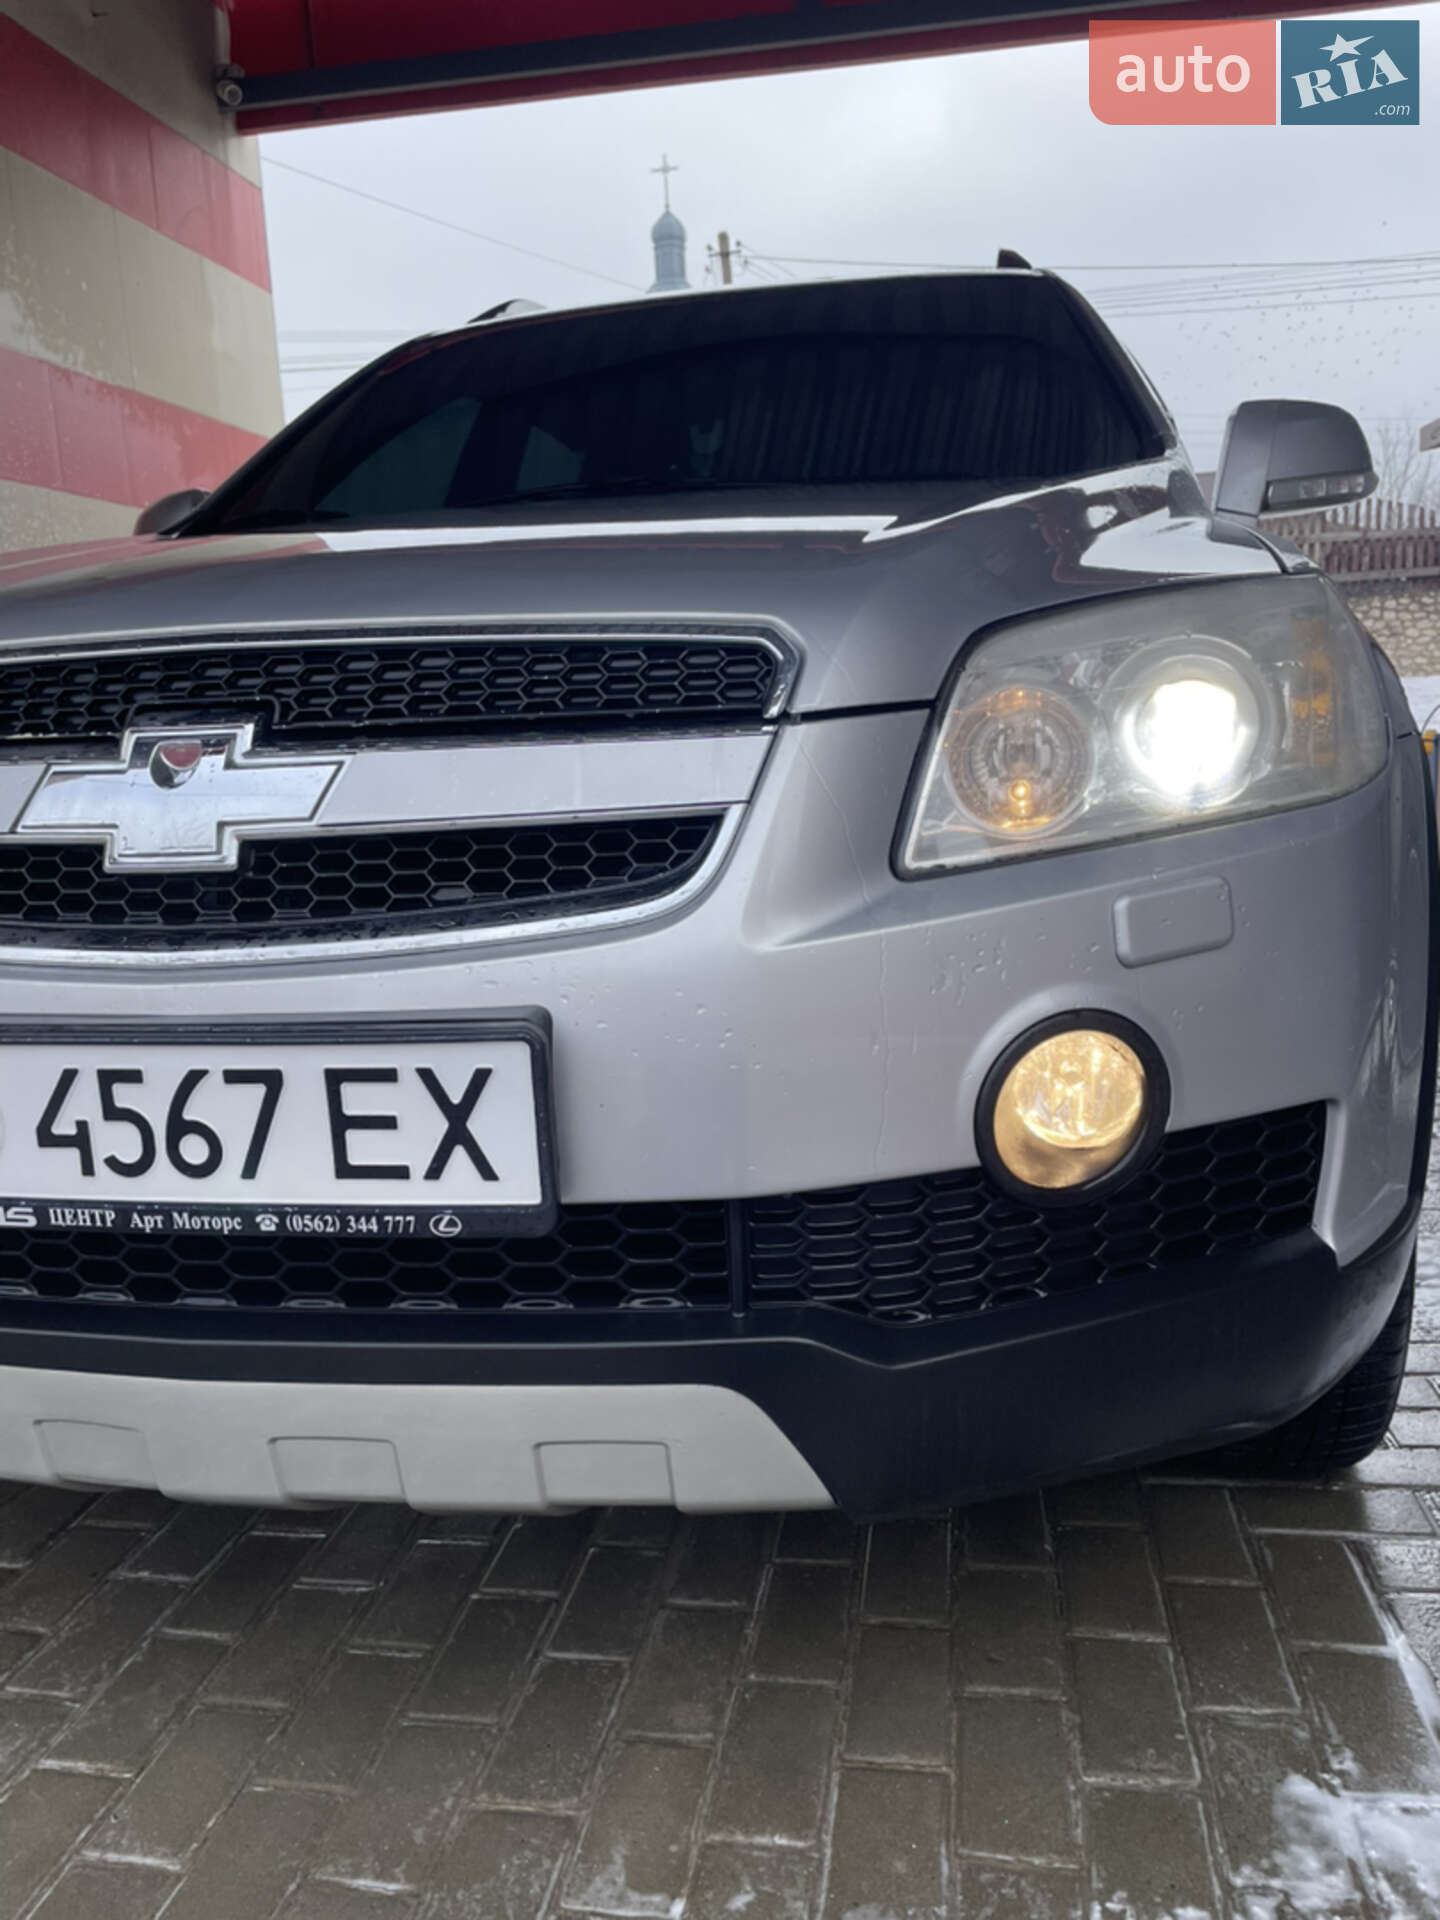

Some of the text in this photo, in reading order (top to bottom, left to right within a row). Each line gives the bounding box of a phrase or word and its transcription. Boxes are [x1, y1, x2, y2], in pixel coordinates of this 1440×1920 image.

[36, 1067, 500, 1180] 4567 EX
[49, 1207, 116, 1227] ЦЕНТР
[130, 1212, 163, 1233] Арт
[173, 1211, 243, 1235] Моторс
[285, 1214, 341, 1233] (0562)
[346, 1215, 378, 1233] 344
[384, 1215, 416, 1234] 777
